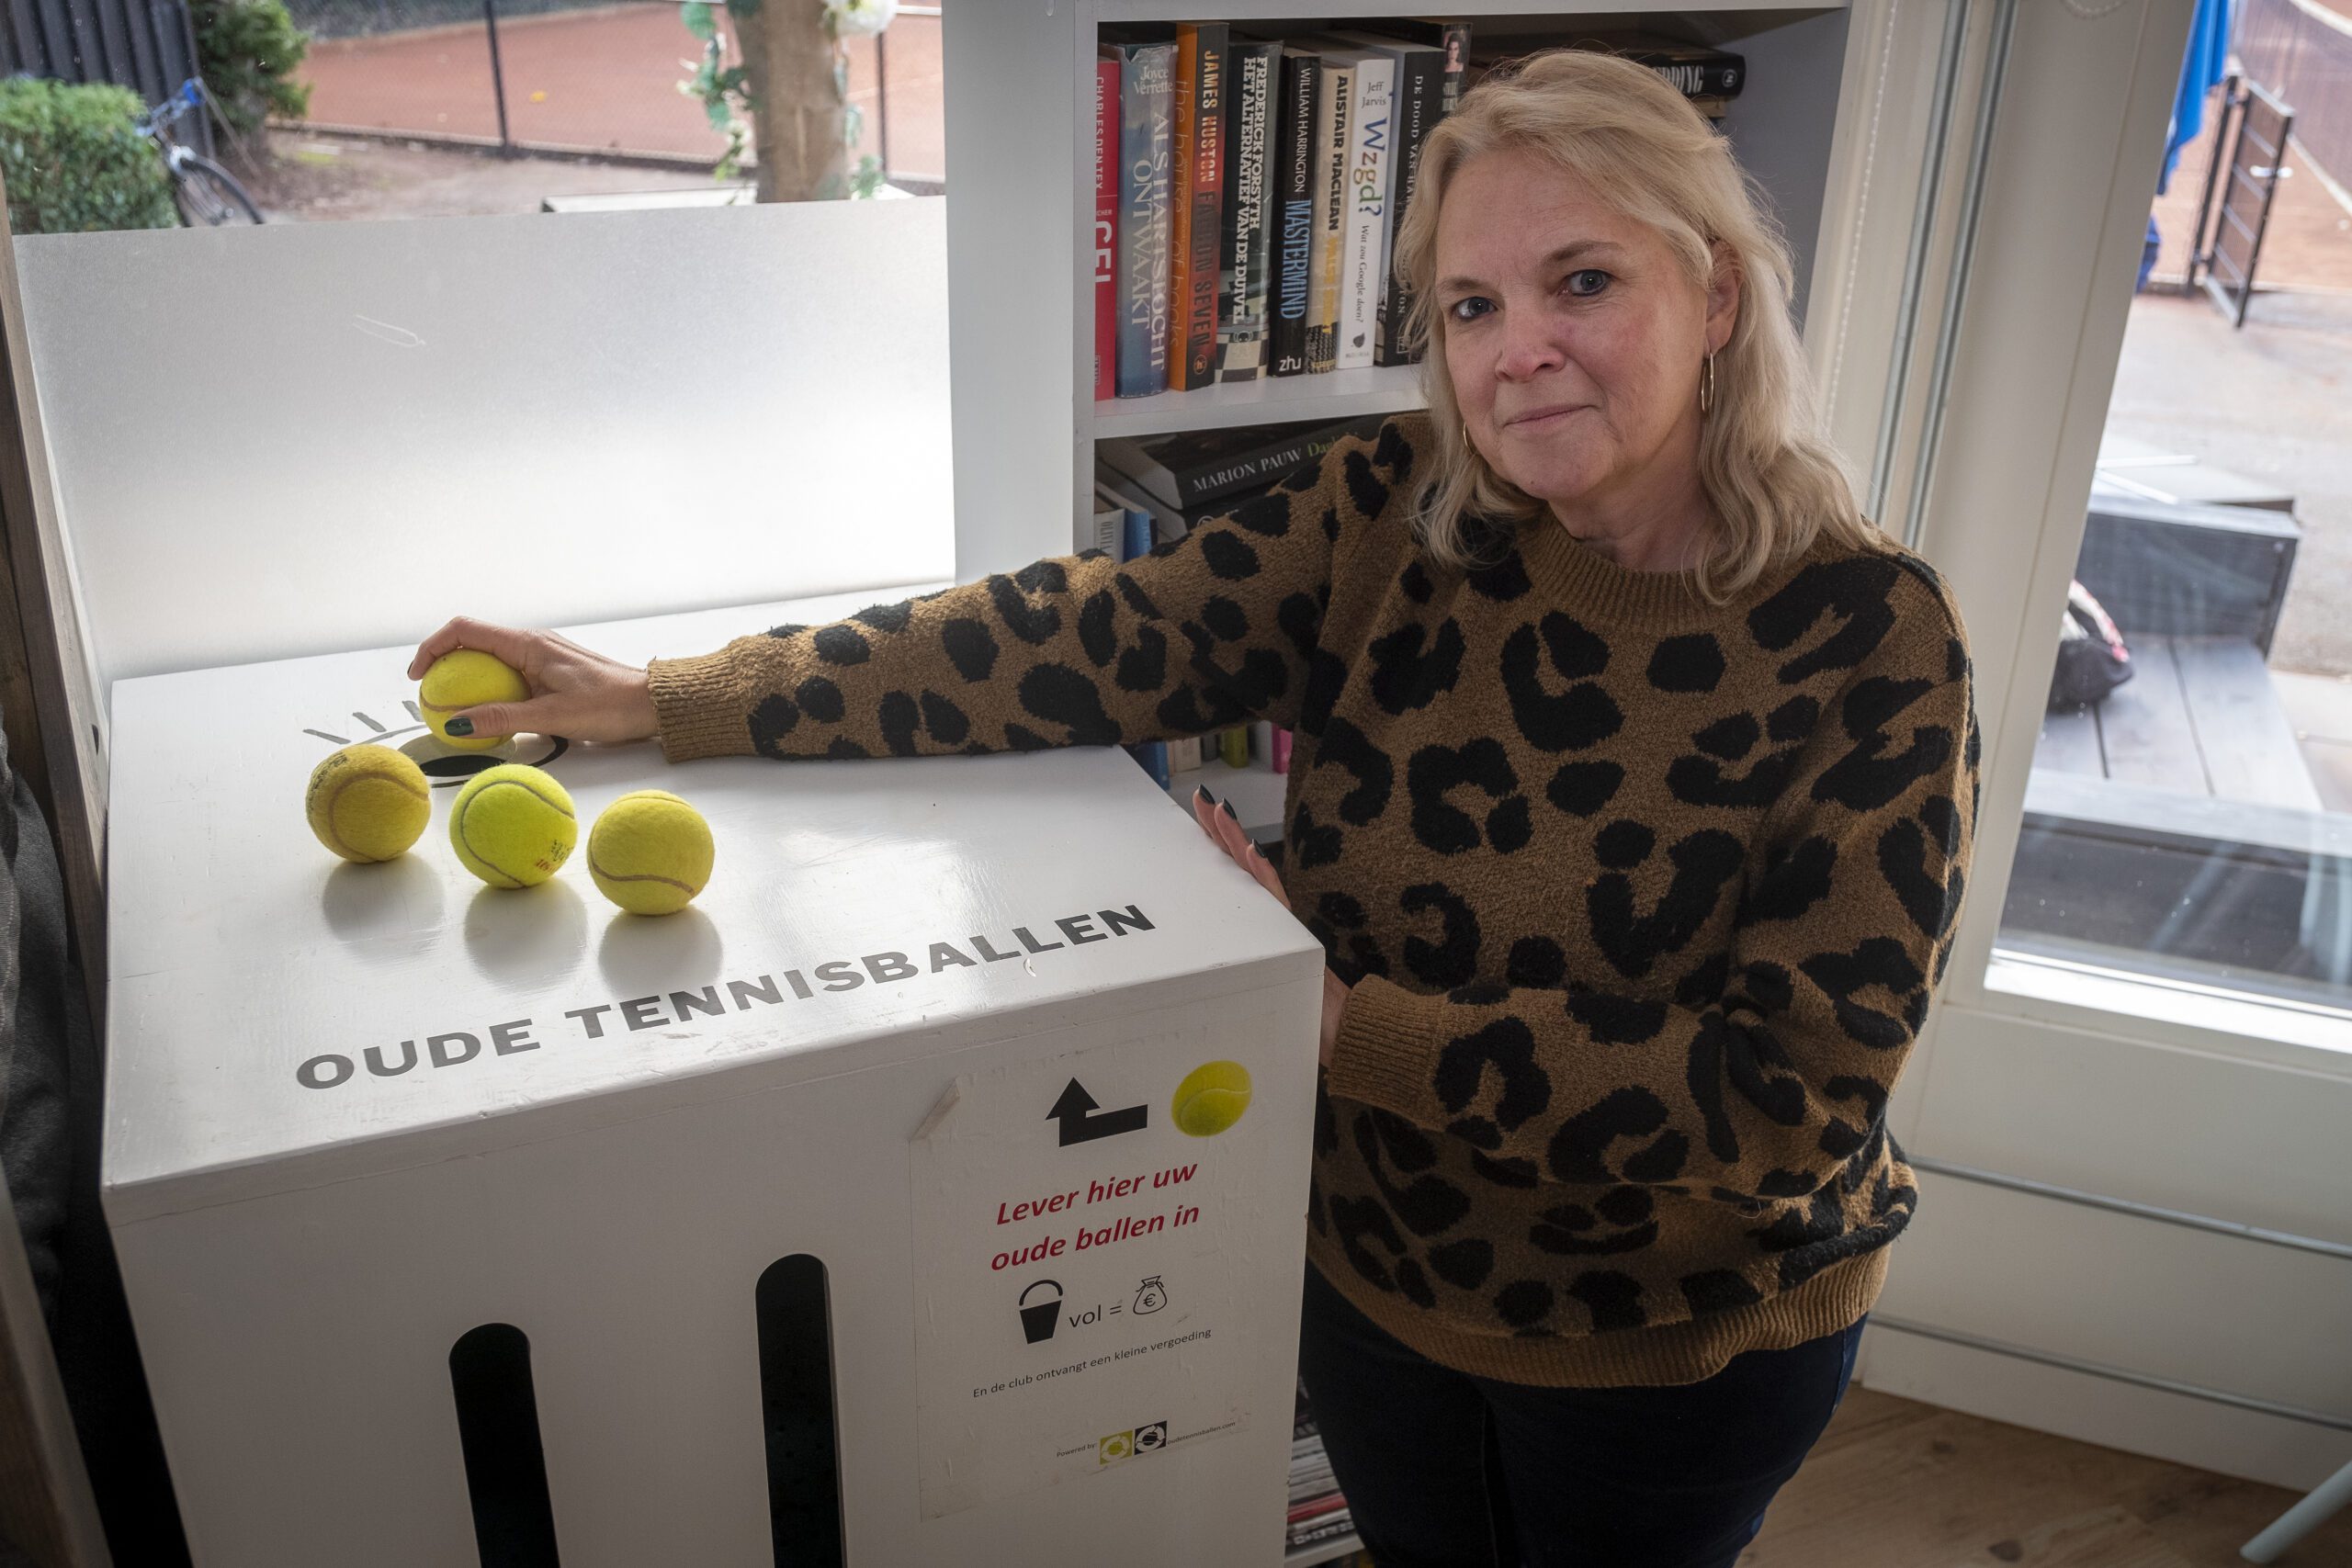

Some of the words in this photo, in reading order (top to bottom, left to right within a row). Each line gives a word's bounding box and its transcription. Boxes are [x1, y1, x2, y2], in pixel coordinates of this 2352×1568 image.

[1134, 80, 1174, 96] Verrette
[1139, 65, 1169, 82] Joyce
[1202, 50, 1220, 109] JAMES
[1242, 57, 1257, 92] HET
[1297, 67, 1312, 118] WILLIAM
[1367, 81, 1385, 94] Jeff
[1414, 75, 1423, 95] DE
[1175, 81, 1190, 123] the
[1253, 56, 1269, 152] FREDERICK
[1333, 75, 1349, 149] ALISTAIR
[1362, 96, 1386, 109] Jarvis
[1411, 100, 1422, 139] DOOD
[1153, 112, 1170, 172] ALS
[1199, 116, 1217, 183] HUSTON
[1238, 93, 1255, 201] ALTERNATIEF
[1294, 121, 1308, 193] HARRINGTON
[1353, 117, 1388, 217] Wzgd?
[1249, 153, 1264, 230] FORSYTH
[1328, 152, 1344, 231] MACLEAN
[1132, 159, 1154, 330] ONTWAAKT
[1236, 205, 1250, 240] VAN
[1360, 224, 1370, 243] Wat
[1235, 242, 1249, 264] DE
[1280, 199, 1312, 319] MASTERMIND
[1359, 245, 1367, 261] zou
[1233, 265, 1248, 324] DUIVEL
[1355, 262, 1368, 296] Google
[1193, 279, 1213, 347] SEVEN
[1354, 297, 1366, 323] doen?
[1279, 355, 1302, 372] zhu
[1193, 462, 1258, 493] MARION
[1260, 447, 1302, 473] PAUW
[297, 1018, 541, 1092] OUDE
[564, 904, 1158, 1040] TENNISBALLEN
[996, 1186, 1080, 1225] Lever
[1085, 1174, 1146, 1206] hier
[1153, 1162, 1198, 1189] uw
[990, 1231, 1065, 1271] oude
[1074, 1213, 1164, 1252] ballen
[1172, 1203, 1200, 1228] in
[1068, 1304, 1102, 1329] vol
[973, 1387, 988, 1398] En
[990, 1382, 1005, 1394] de
[1009, 1374, 1033, 1389] club
[1035, 1360, 1088, 1382] ontvangt
[1090, 1355, 1111, 1368] een
[1114, 1345, 1148, 1361] kleine
[1150, 1329, 1212, 1352] vergoeding
[1057, 1445, 1086, 1459] Powered
